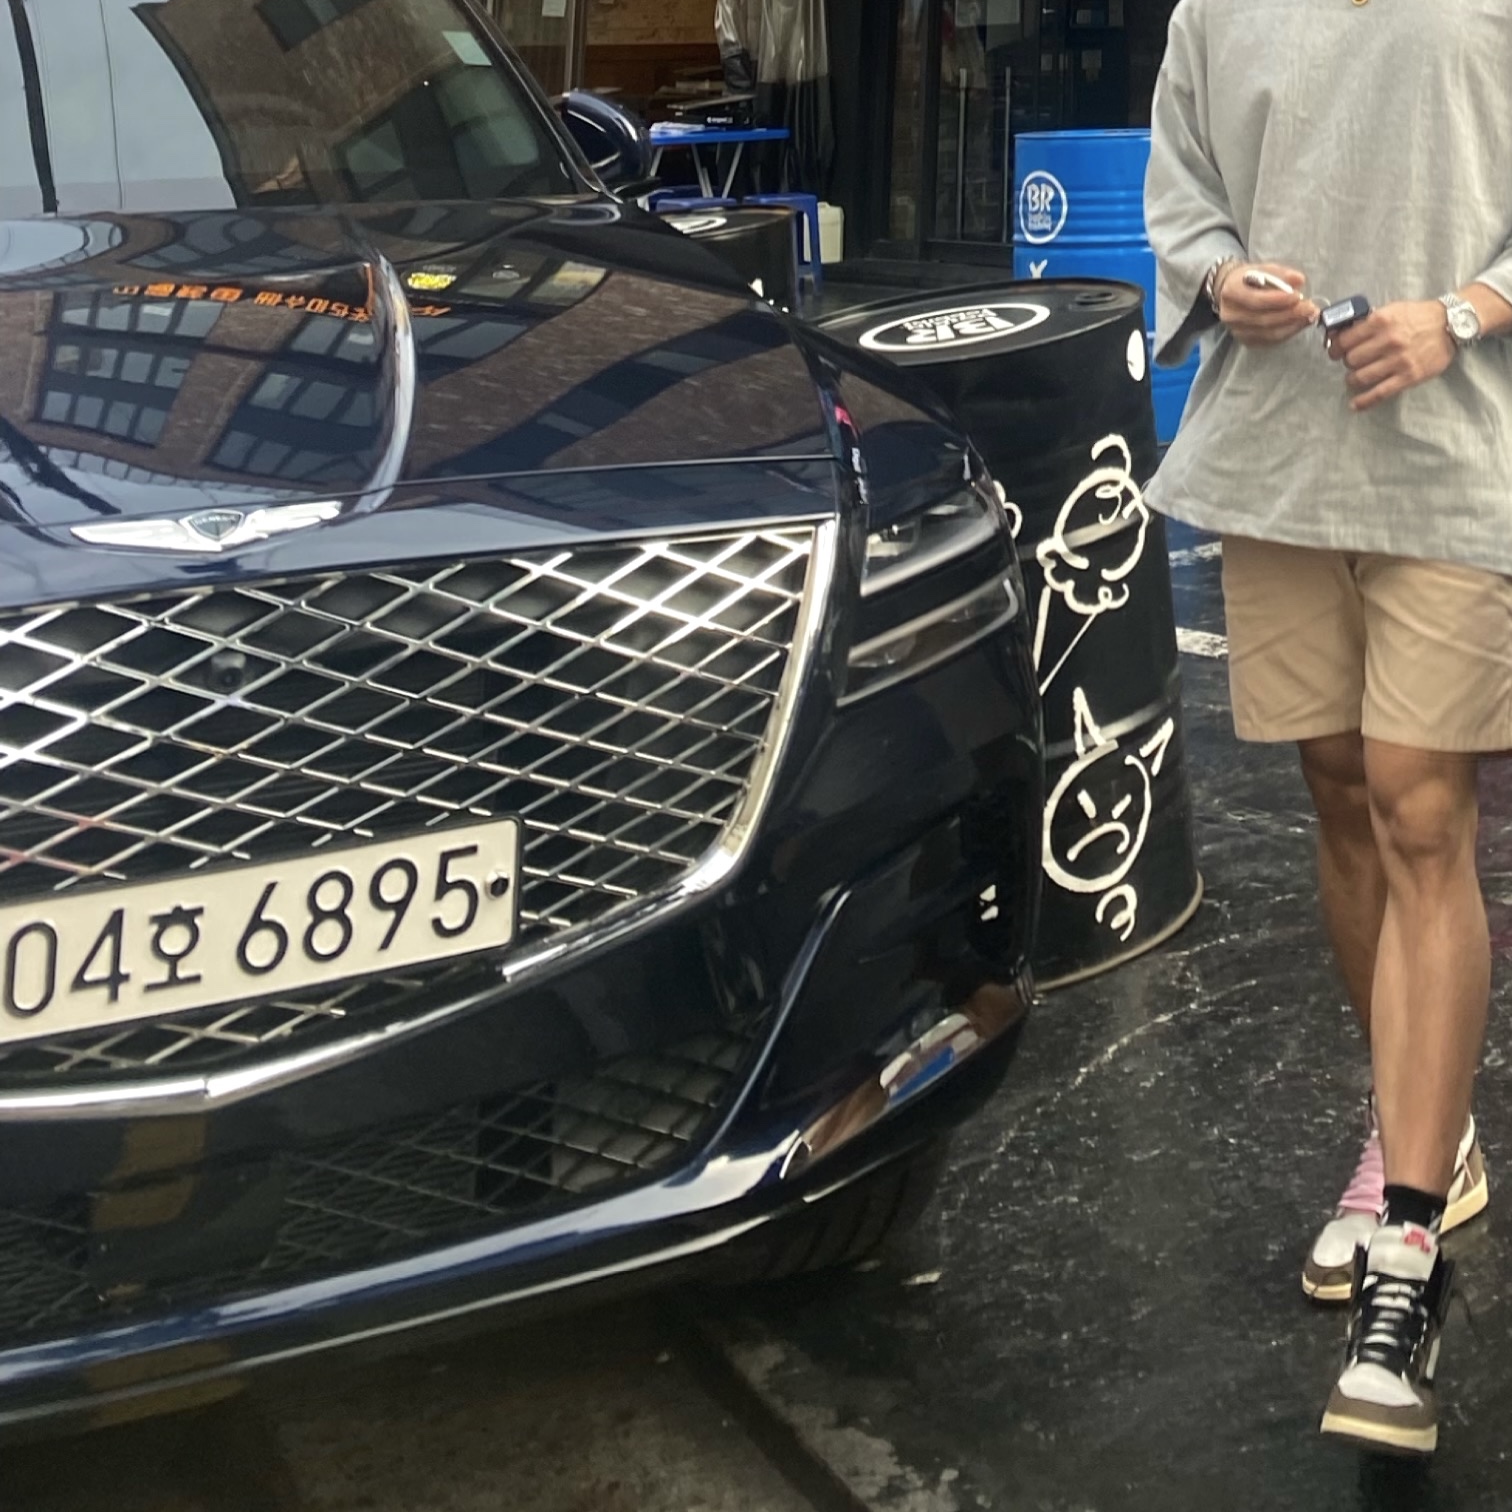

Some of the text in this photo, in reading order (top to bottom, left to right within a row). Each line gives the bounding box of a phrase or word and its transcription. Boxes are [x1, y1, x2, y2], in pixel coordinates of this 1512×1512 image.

[1026, 183, 1055, 213] BR
[6, 844, 479, 1018] 04호 6895
